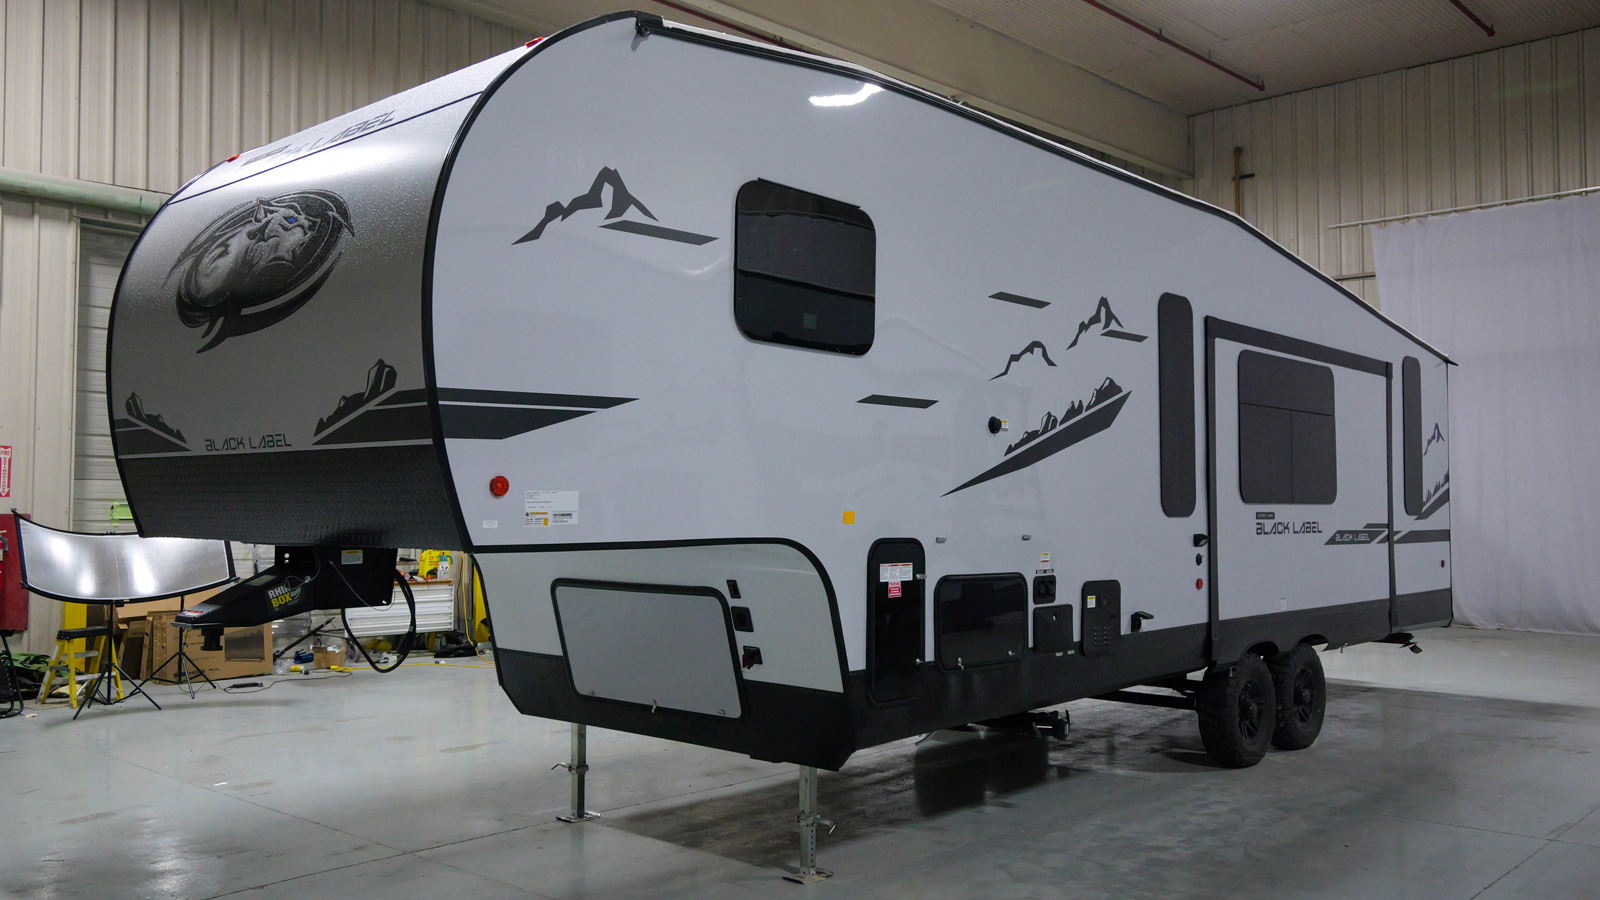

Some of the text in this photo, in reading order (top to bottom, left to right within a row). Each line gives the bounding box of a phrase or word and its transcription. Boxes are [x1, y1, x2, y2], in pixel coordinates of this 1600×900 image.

[307, 110, 395, 151] LABEL
[205, 433, 292, 451] BLACK LABEL
[1256, 521, 1322, 535] BLACK LABEL
[1335, 533, 1370, 541] BLACK LABEL
[271, 592, 292, 607] BOX
